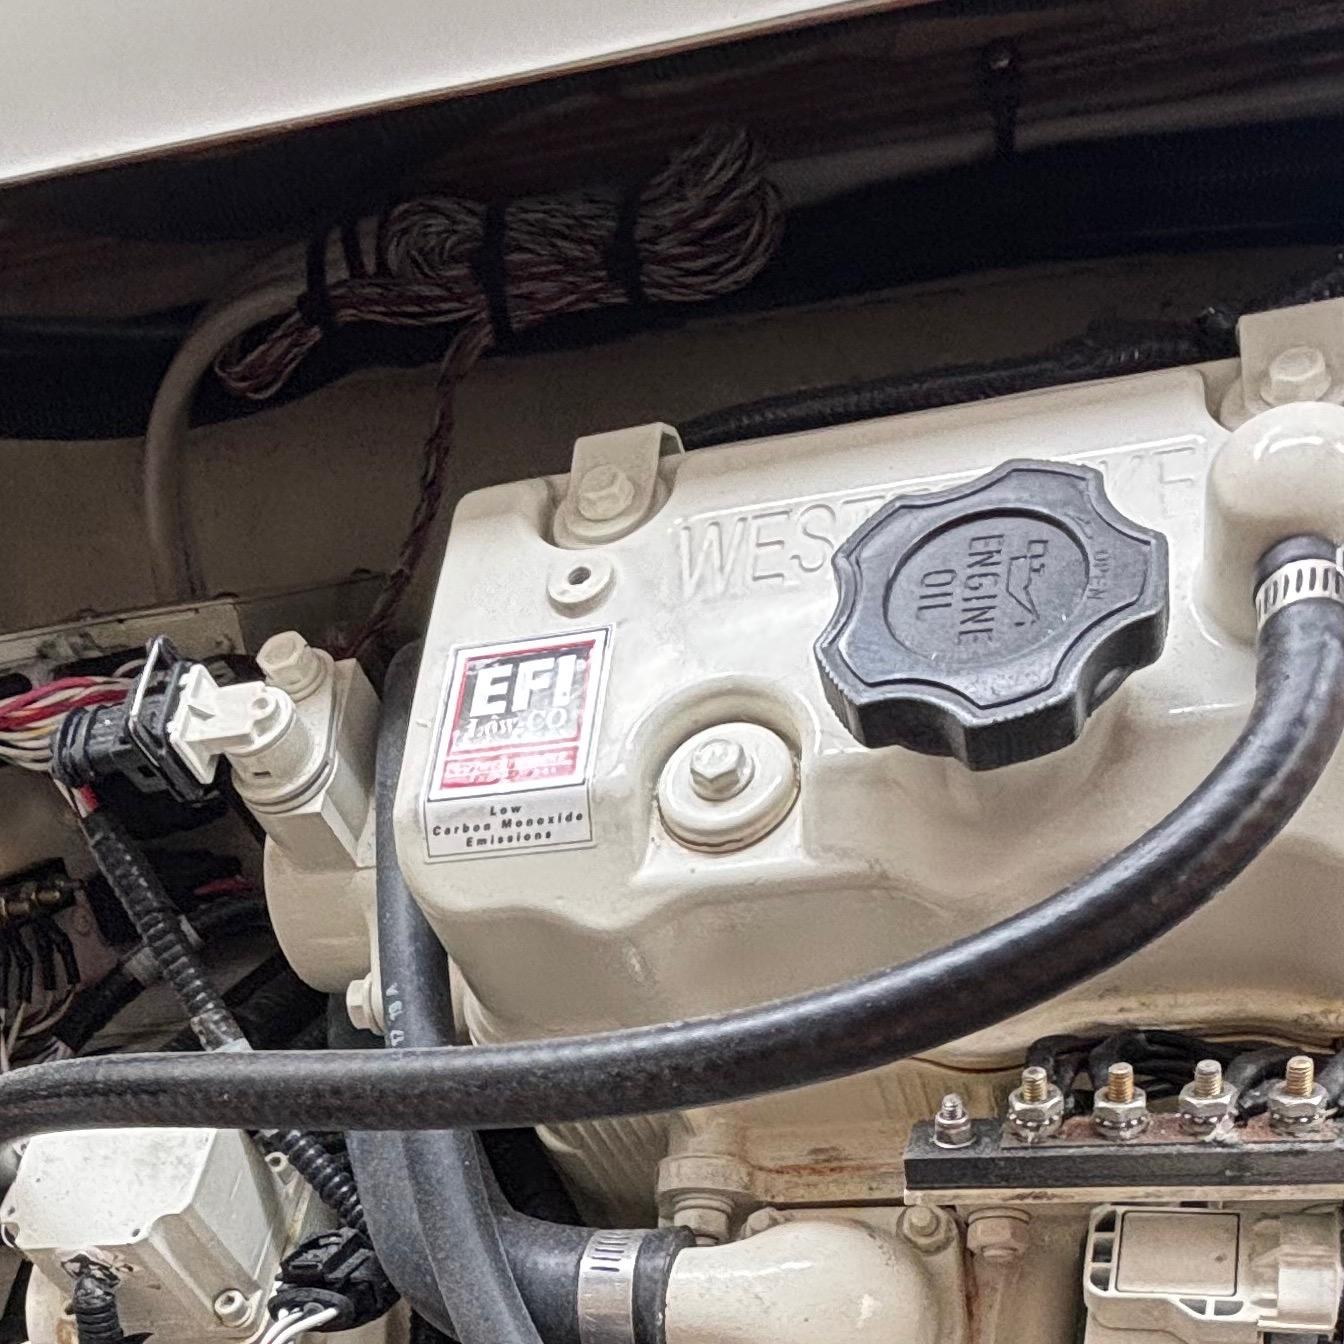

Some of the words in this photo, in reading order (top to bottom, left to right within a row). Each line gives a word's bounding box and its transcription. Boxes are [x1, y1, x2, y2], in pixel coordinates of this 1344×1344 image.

[915, 568, 958, 622] OIL
[958, 533, 1006, 645] ENGINE
[469, 654, 578, 718] EFI
[432, 822, 492, 837] Carbon
[501, 811, 584, 829] Monoxide
[490, 804, 523, 817] Low
[465, 830, 552, 848] Emissions
